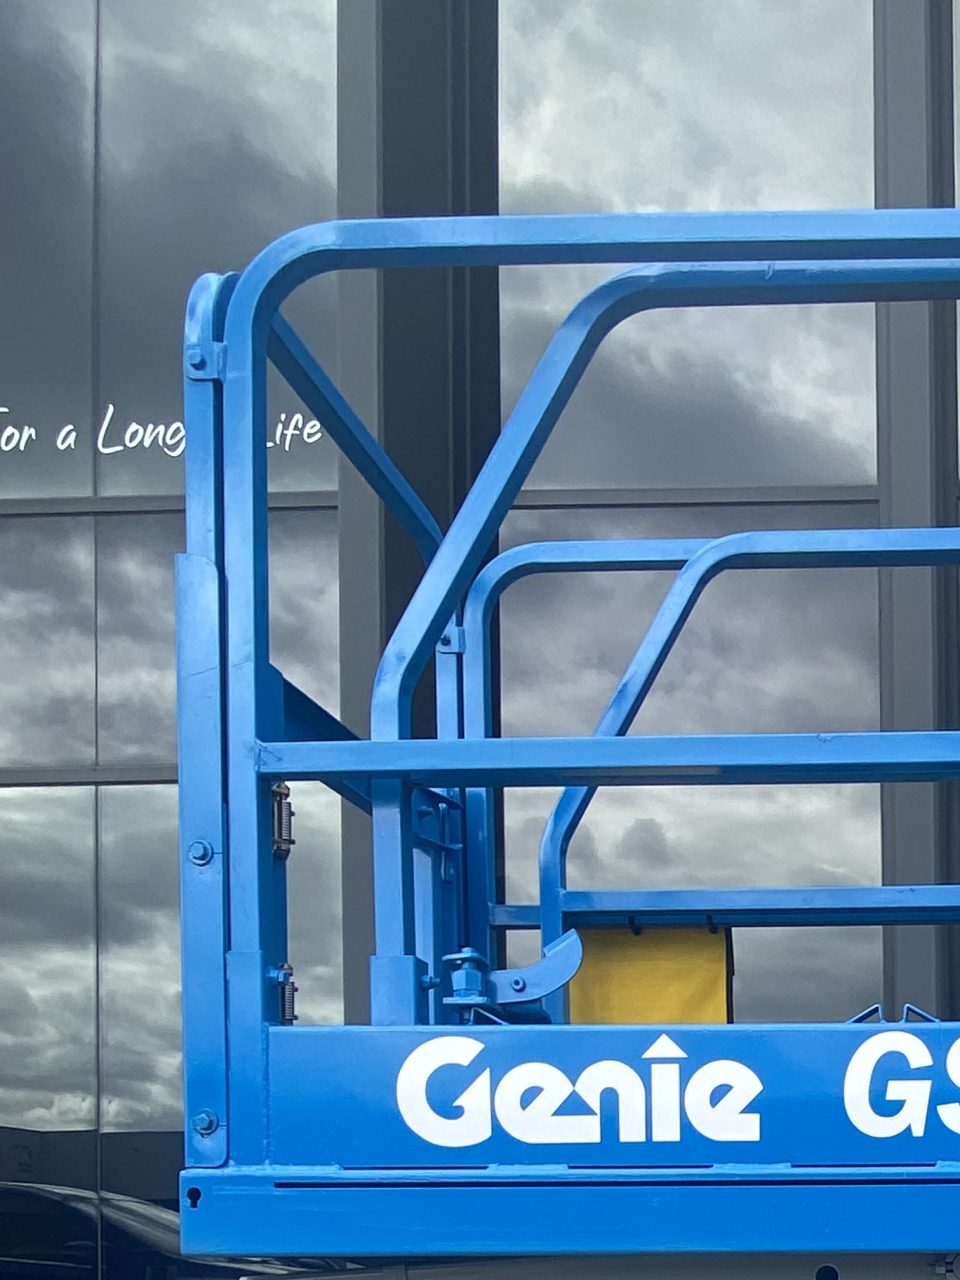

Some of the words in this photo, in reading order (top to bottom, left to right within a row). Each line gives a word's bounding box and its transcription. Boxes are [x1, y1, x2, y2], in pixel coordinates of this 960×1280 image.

[0, 406, 36, 451] or
[56, 424, 77, 450] a
[266, 413, 322, 451] ife
[397, 1033, 763, 1147] Genie
